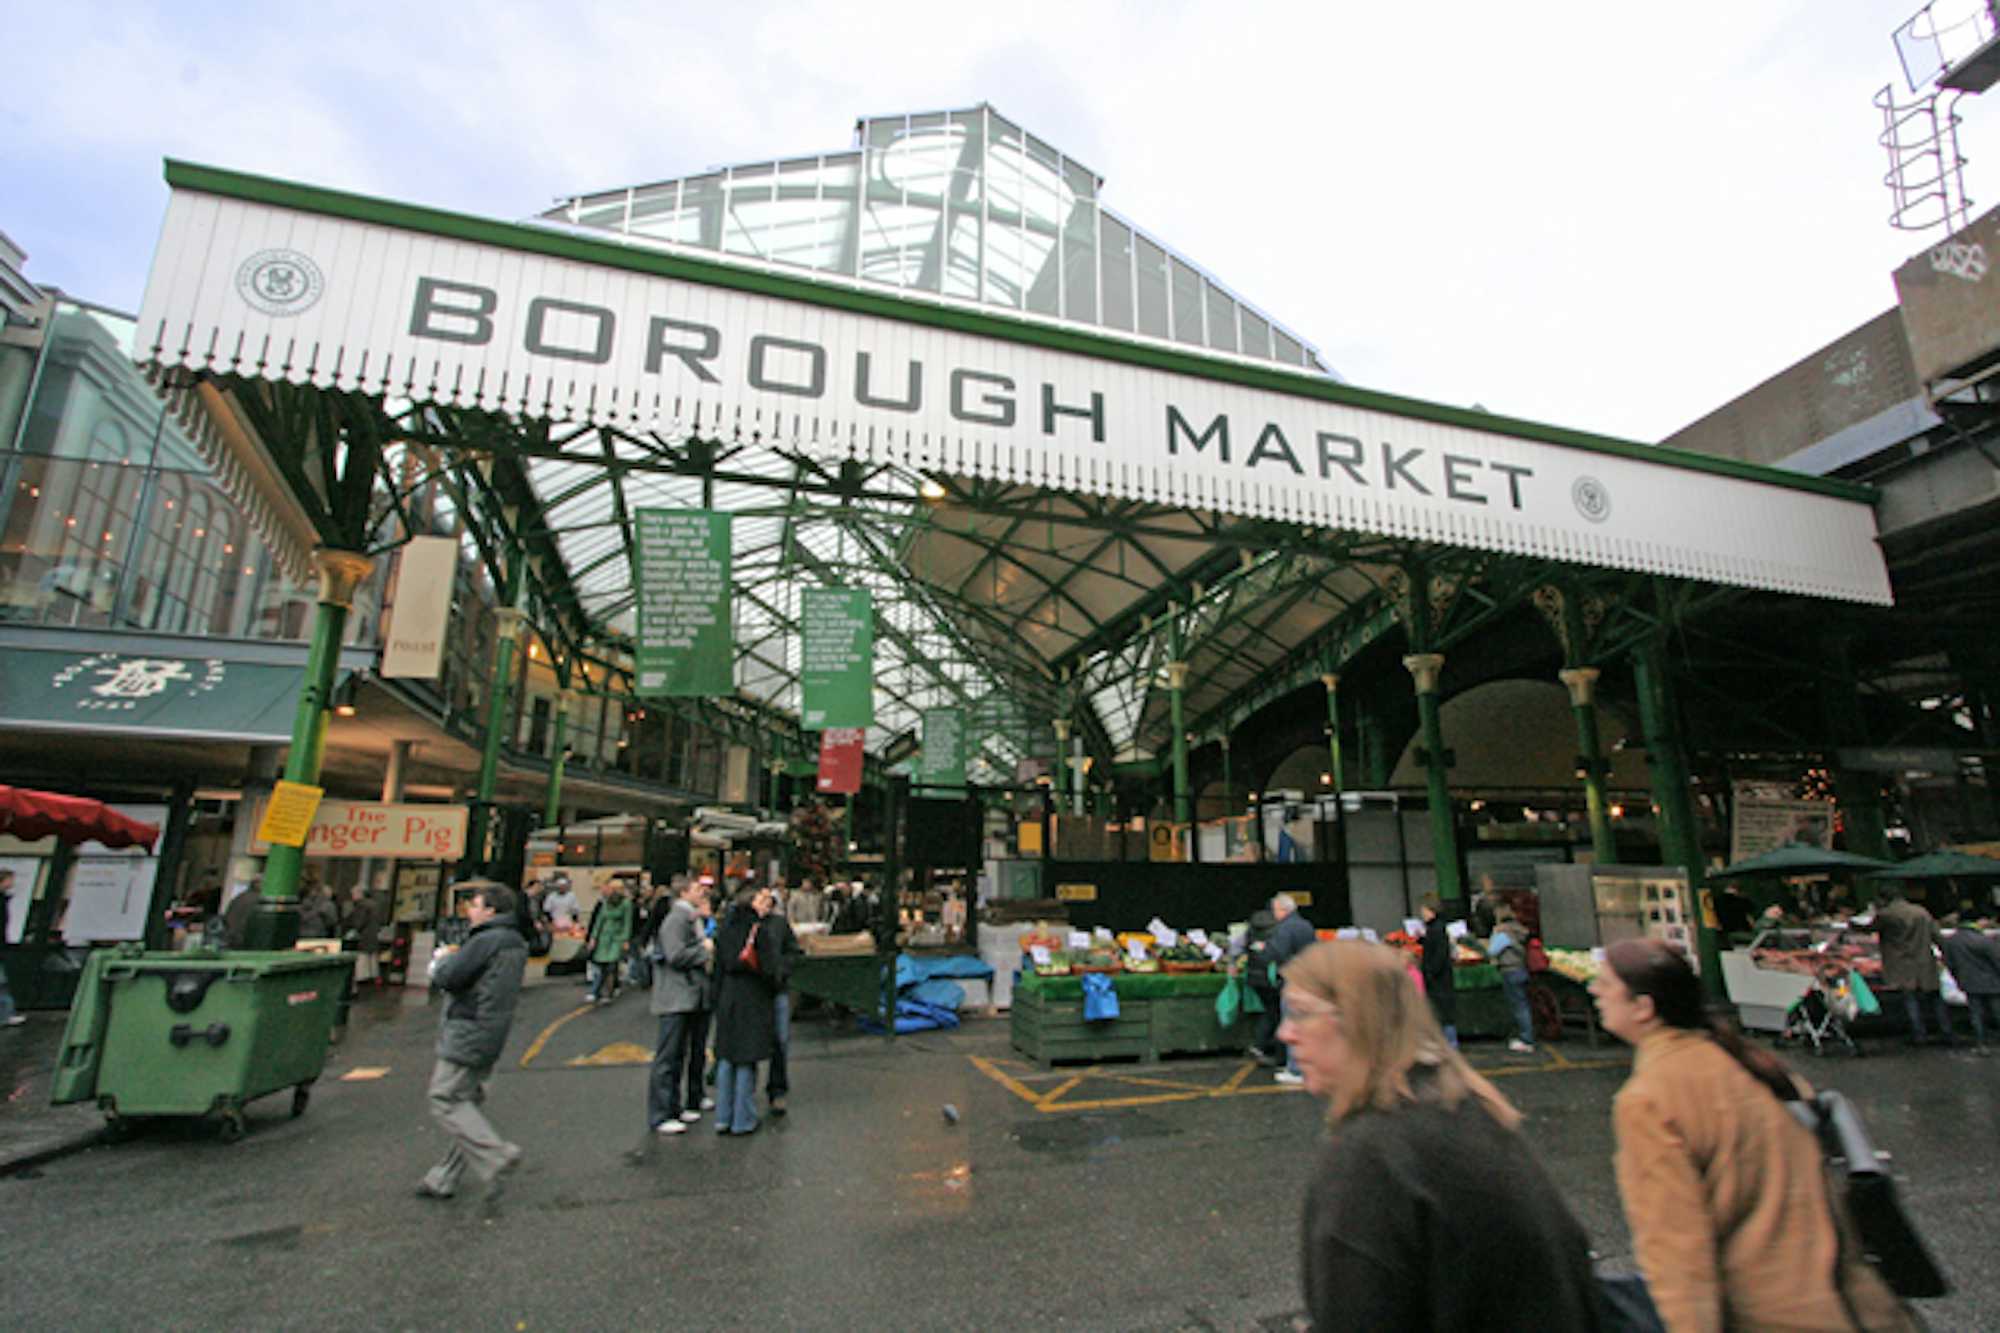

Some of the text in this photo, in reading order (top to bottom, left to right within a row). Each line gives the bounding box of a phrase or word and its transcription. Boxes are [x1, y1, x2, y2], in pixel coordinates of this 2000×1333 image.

[409, 276, 1105, 443] BOROUGH
[1166, 404, 1534, 510] MARKET
[346, 805, 387, 823] The
[308, 816, 453, 852] nger Pig
